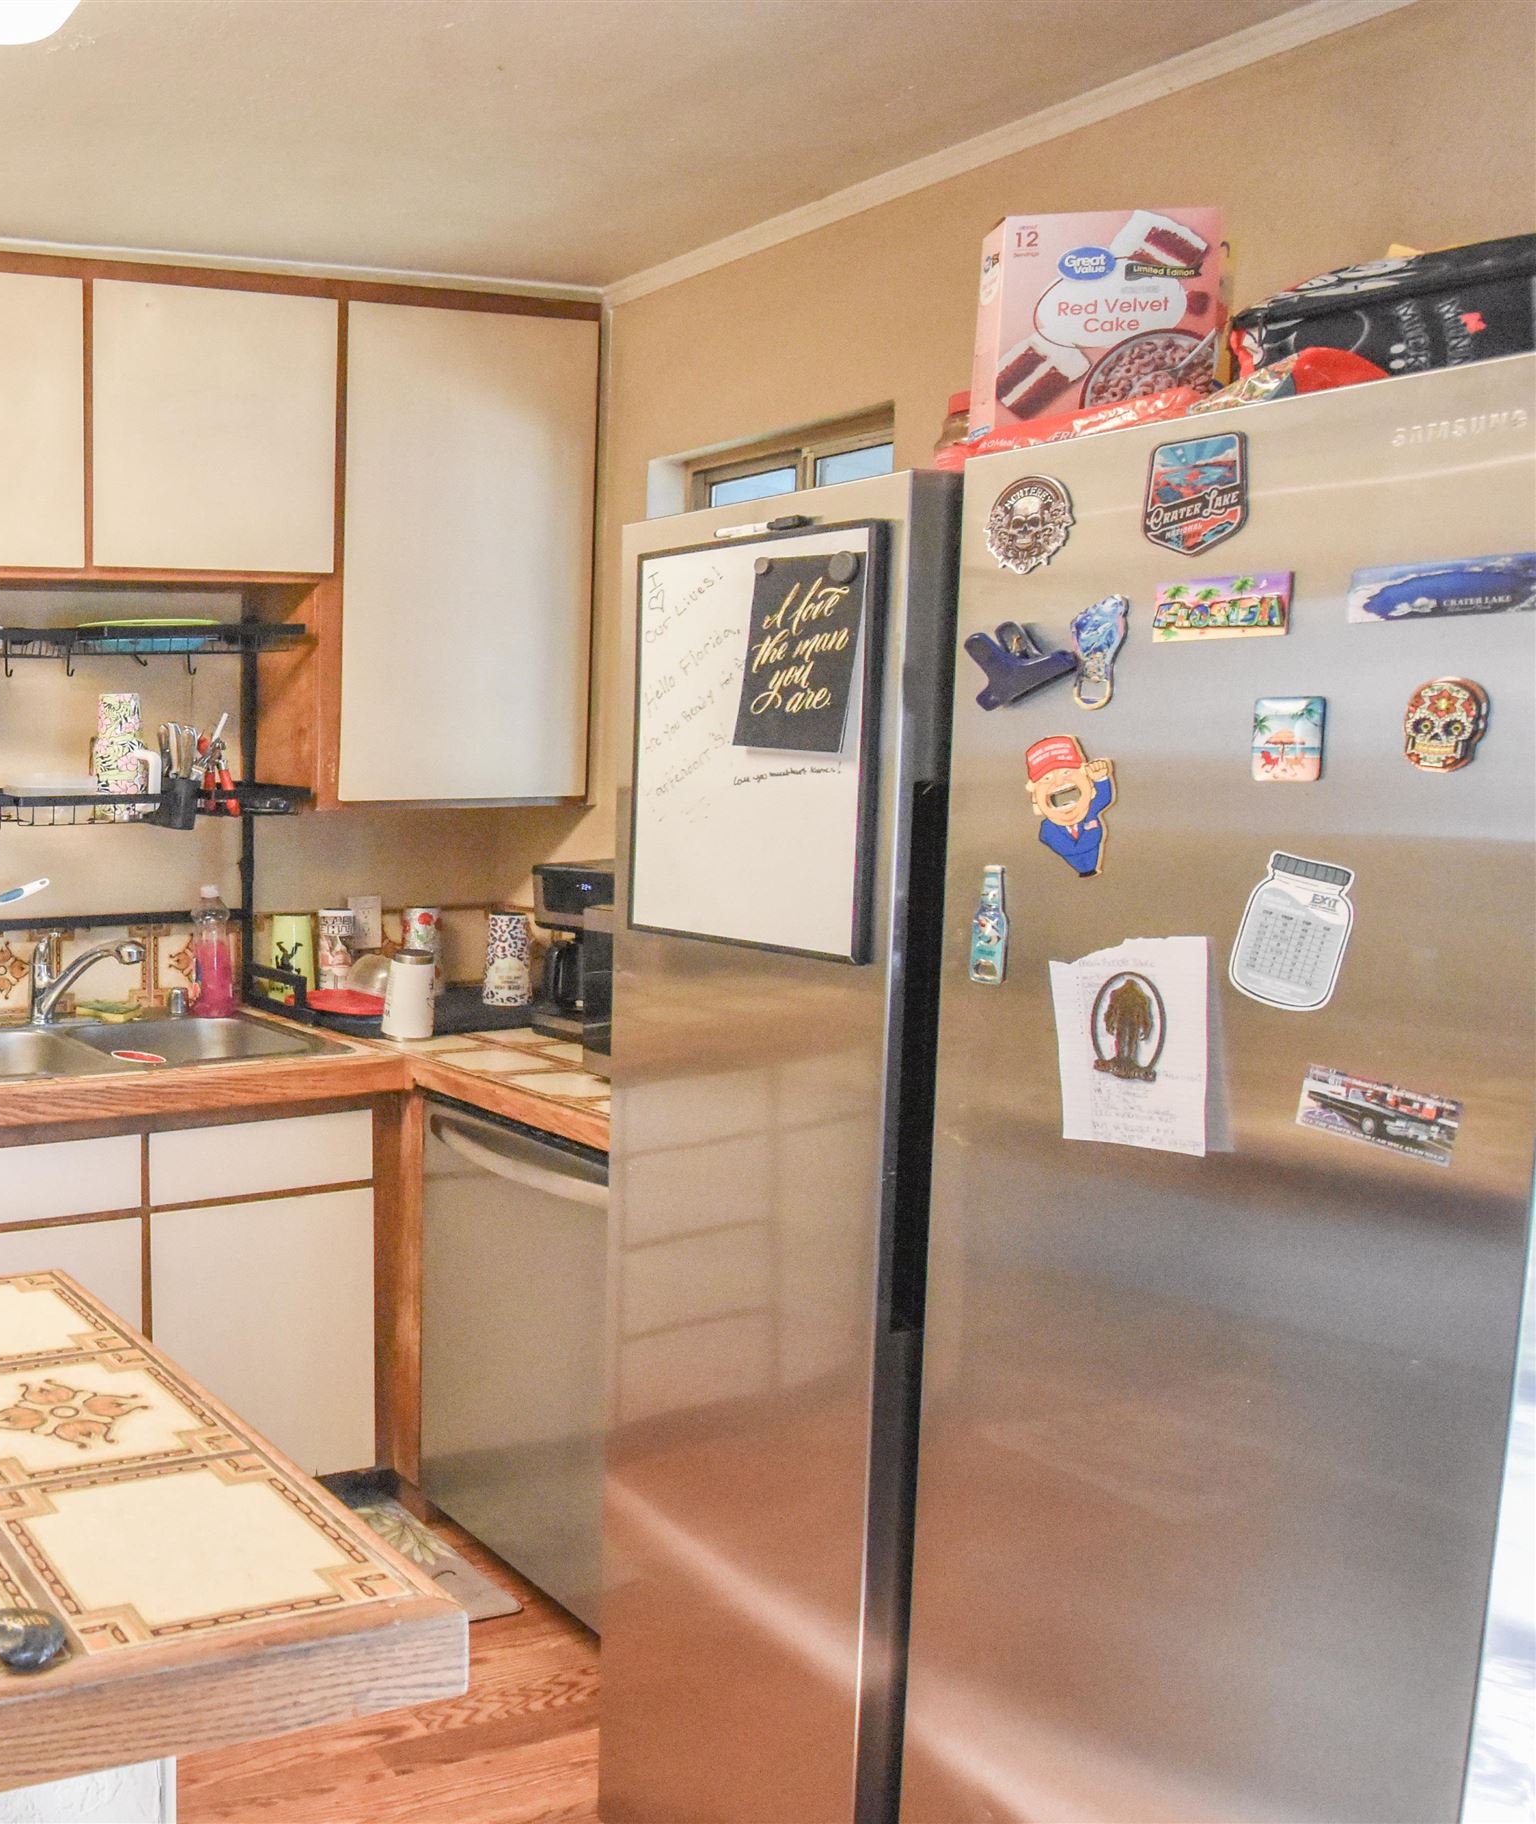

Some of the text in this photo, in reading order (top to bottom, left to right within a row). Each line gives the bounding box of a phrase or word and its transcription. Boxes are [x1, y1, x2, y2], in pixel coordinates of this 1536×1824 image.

[1016, 231, 1039, 248] 12
[1064, 254, 1106, 267] Great
[1073, 265, 1106, 274] Value
[1133, 265, 1195, 277] Limited Edition
[1057, 297, 1169, 316] Red Velvet
[1083, 317, 1140, 333] Cake
[1391, 409, 1529, 447] SAMSUNG
[1004, 486, 1053, 510] MONTEREY
[1146, 489, 1240, 531] CRATER LAKE
[648, 571, 664, 594] I
[762, 576, 850, 636] I love
[1443, 595, 1513, 606] CRATER LAKE
[791, 627, 850, 663] man
[750, 660, 815, 716] you
[784, 687, 833, 714] are.
